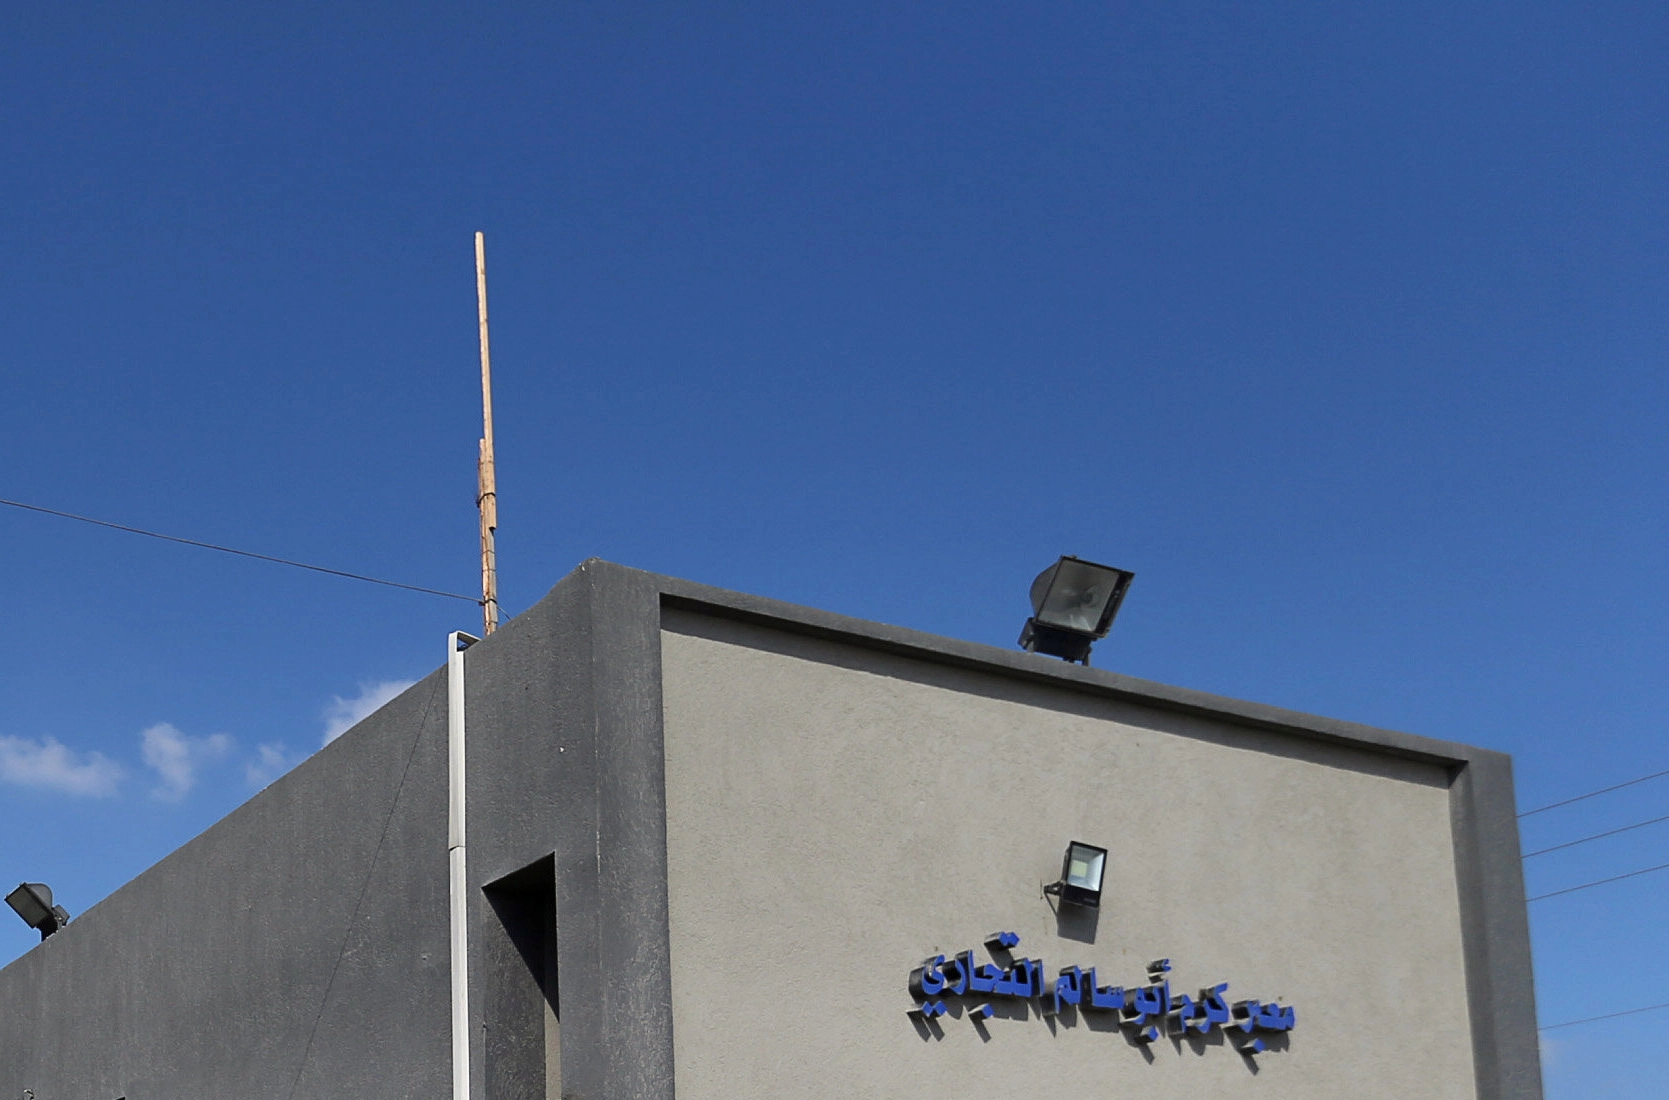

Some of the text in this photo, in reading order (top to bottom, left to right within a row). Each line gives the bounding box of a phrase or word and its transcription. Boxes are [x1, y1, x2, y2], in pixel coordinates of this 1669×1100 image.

[916, 931, 1296, 1054] معبر كرم أبو سالم التجاري
